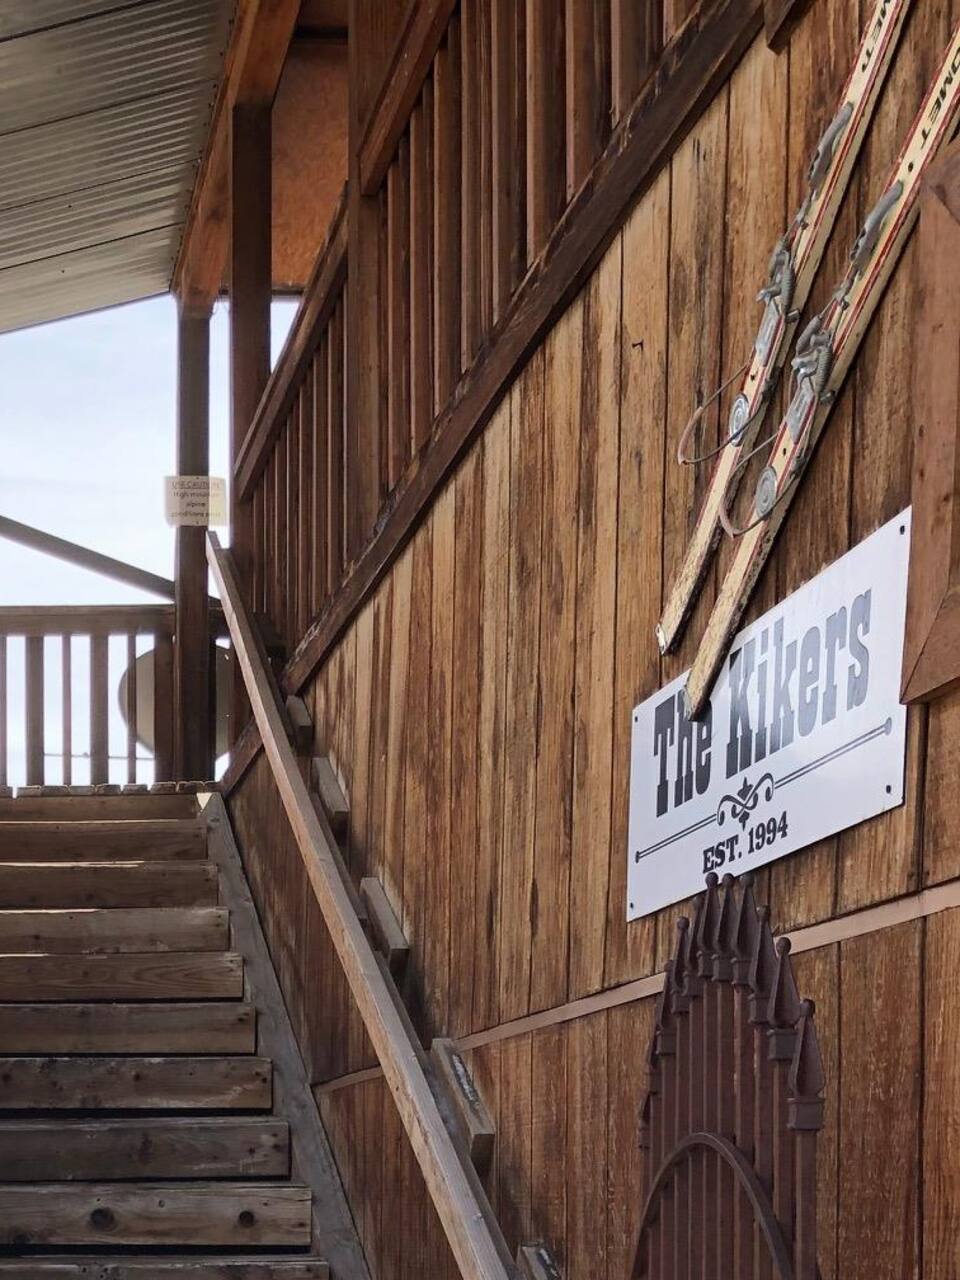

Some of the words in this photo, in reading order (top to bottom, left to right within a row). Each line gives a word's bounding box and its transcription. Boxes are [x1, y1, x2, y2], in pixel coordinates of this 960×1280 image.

[654, 689, 713, 818] The
[726, 588, 872, 779] Kikers
[702, 834, 742, 875] EST.
[748, 810, 789, 855] 1994
